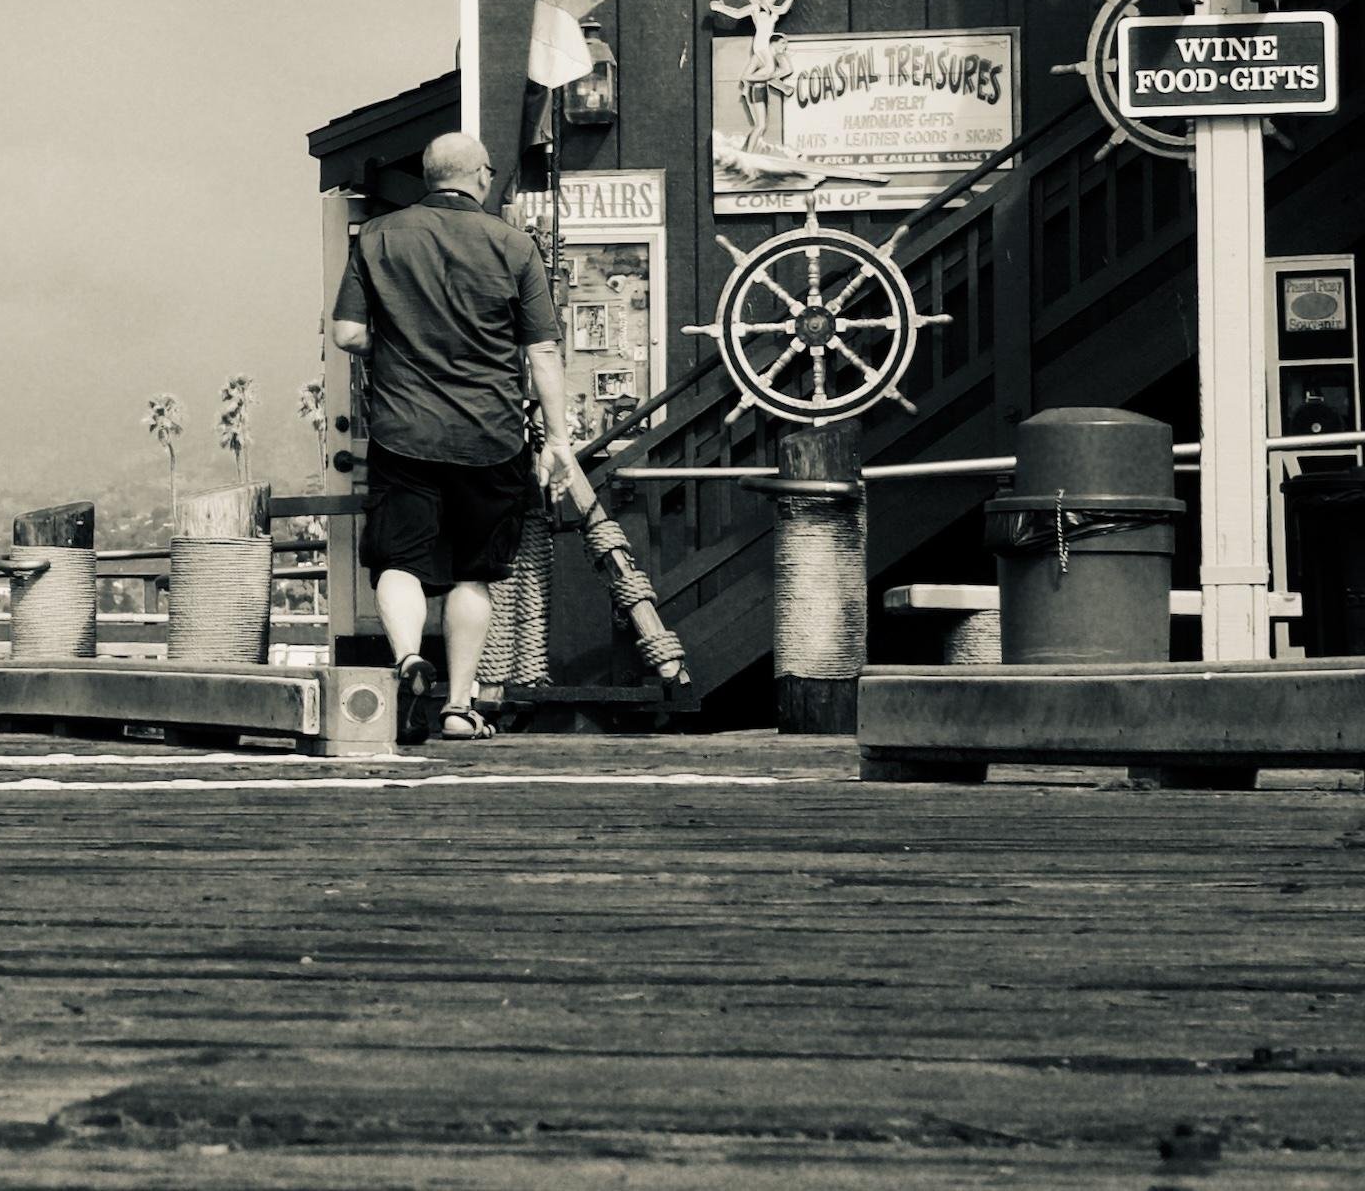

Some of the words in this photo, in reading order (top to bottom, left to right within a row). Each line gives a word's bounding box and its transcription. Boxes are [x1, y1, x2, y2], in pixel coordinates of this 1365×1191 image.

[1175, 35, 1278, 63] WINE
[796, 46, 879, 109] COASTAL
[884, 43, 1003, 105] TREASURES
[1135, 68, 1218, 94] FOOD
[1229, 64, 1319, 91] GIFTS
[869, 95, 926, 111] JEWELRY
[843, 112, 915, 129] HANDMADE
[919, 112, 954, 127] GIFTS
[796, 133, 827, 148] HATS
[845, 131, 900, 147] LEATHER
[904, 130, 948, 145] GOODS
[965, 128, 1004, 144] SIGNS
[814, 155, 853, 165] CATCH
[858, 155, 869, 164] A
[872, 153, 941, 164] BEAUTIFUL
[945, 151, 992, 162] SUNSET
[735, 193, 795, 208] COME
[804, 192, 831, 206] N
[840, 191, 871, 207] UP
